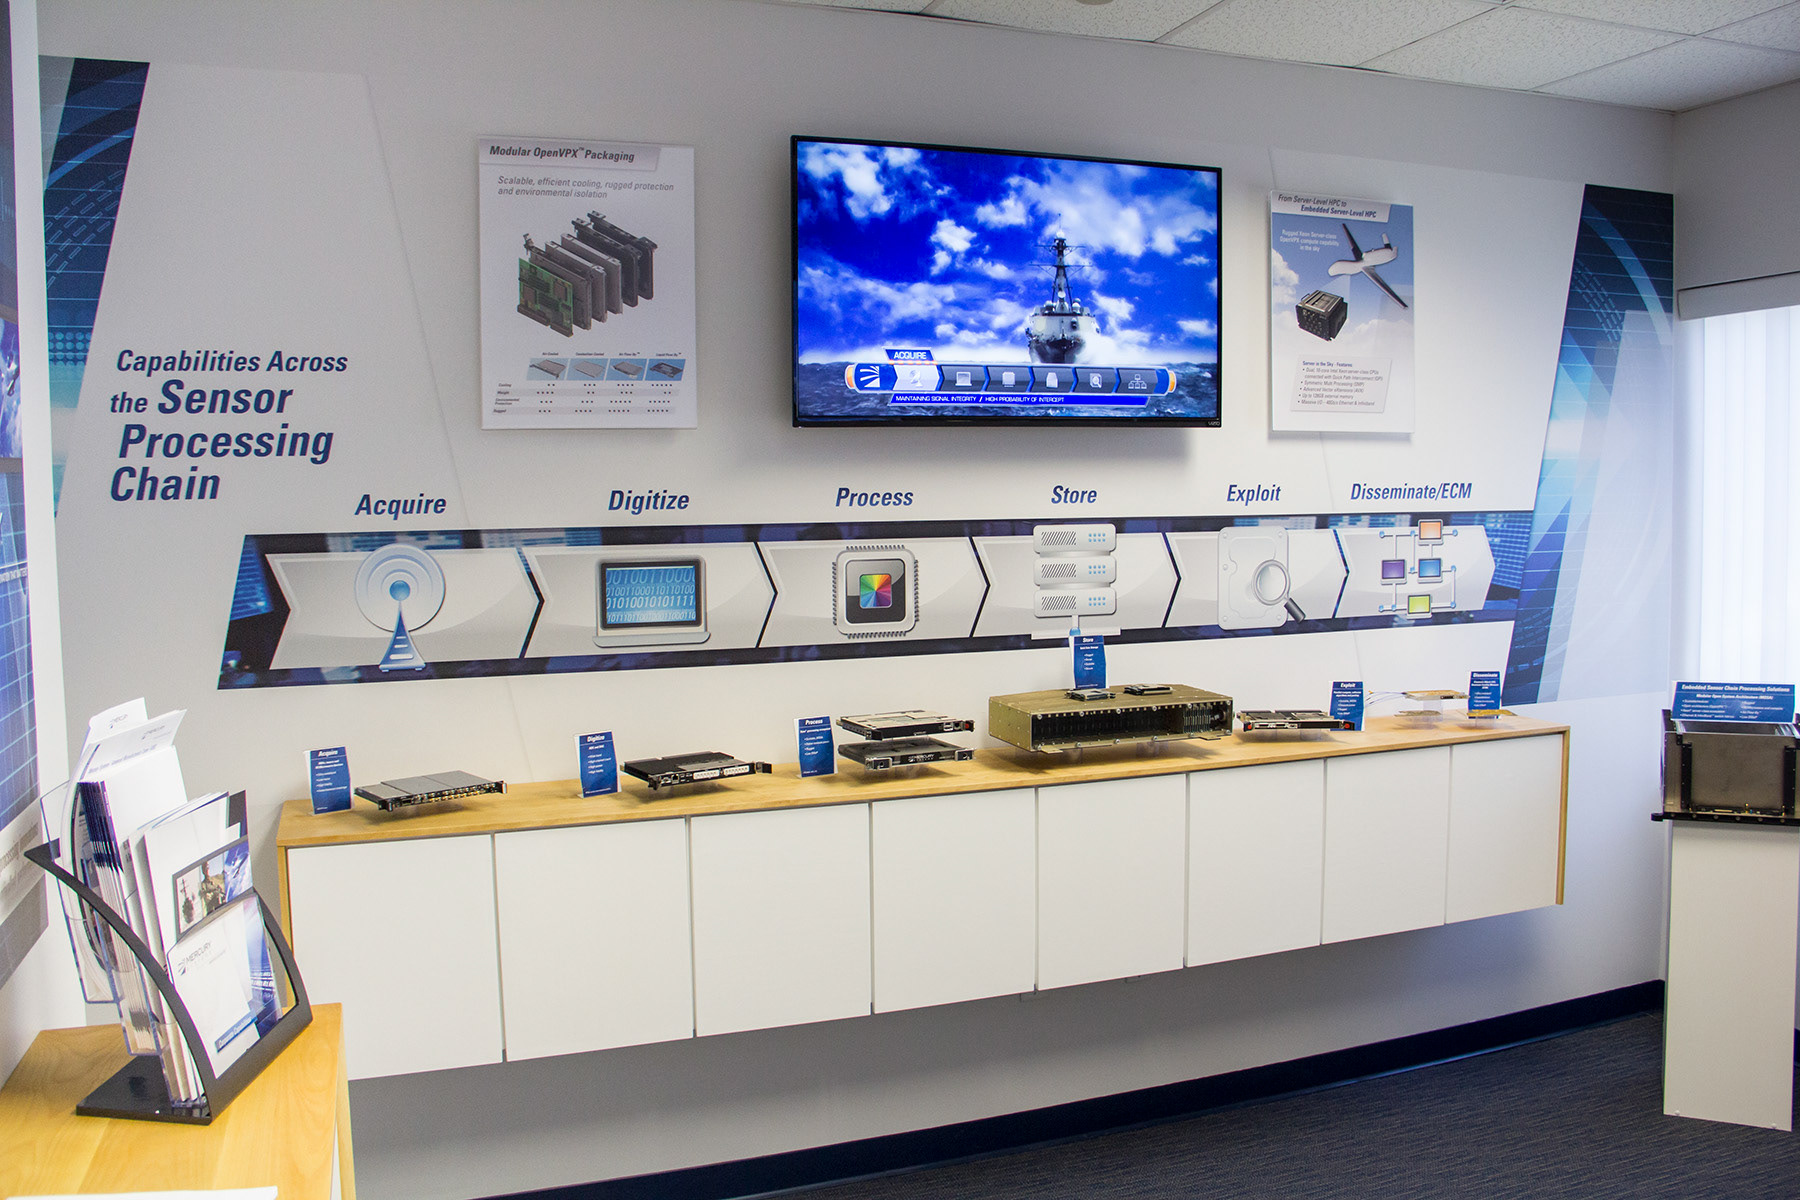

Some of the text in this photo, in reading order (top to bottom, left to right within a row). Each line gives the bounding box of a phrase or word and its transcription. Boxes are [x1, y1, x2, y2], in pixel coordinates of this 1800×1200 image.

[489, 145, 532, 157] Modular
[584, 149, 635, 163] Packaging
[498, 175, 674, 191] Scalable, efficient cooling, rugged protection
[498, 187, 608, 199] and environmental isolation
[1278, 193, 1293, 202] From
[1293, 195, 1328, 206] Server-Level
[1328, 199, 1341, 207] HPC
[1301, 204, 1330, 214] Embedded
[1330, 208, 1364, 217] Server-Level
[116, 349, 348, 377] Capabilities Across
[893, 351, 927, 360] ACQUIRE
[110, 379, 294, 414] the Sensor
[118, 423, 334, 465] Processing
[110, 466, 221, 502] Chain
[1350, 483, 1473, 500] Disseminate/ECM
[608, 489, 690, 515] Digitize
[835, 487, 914, 507] Process
[1051, 485, 1097, 504] Store
[1226, 484, 1282, 506] Exploit
[354, 493, 447, 520] Acquire
